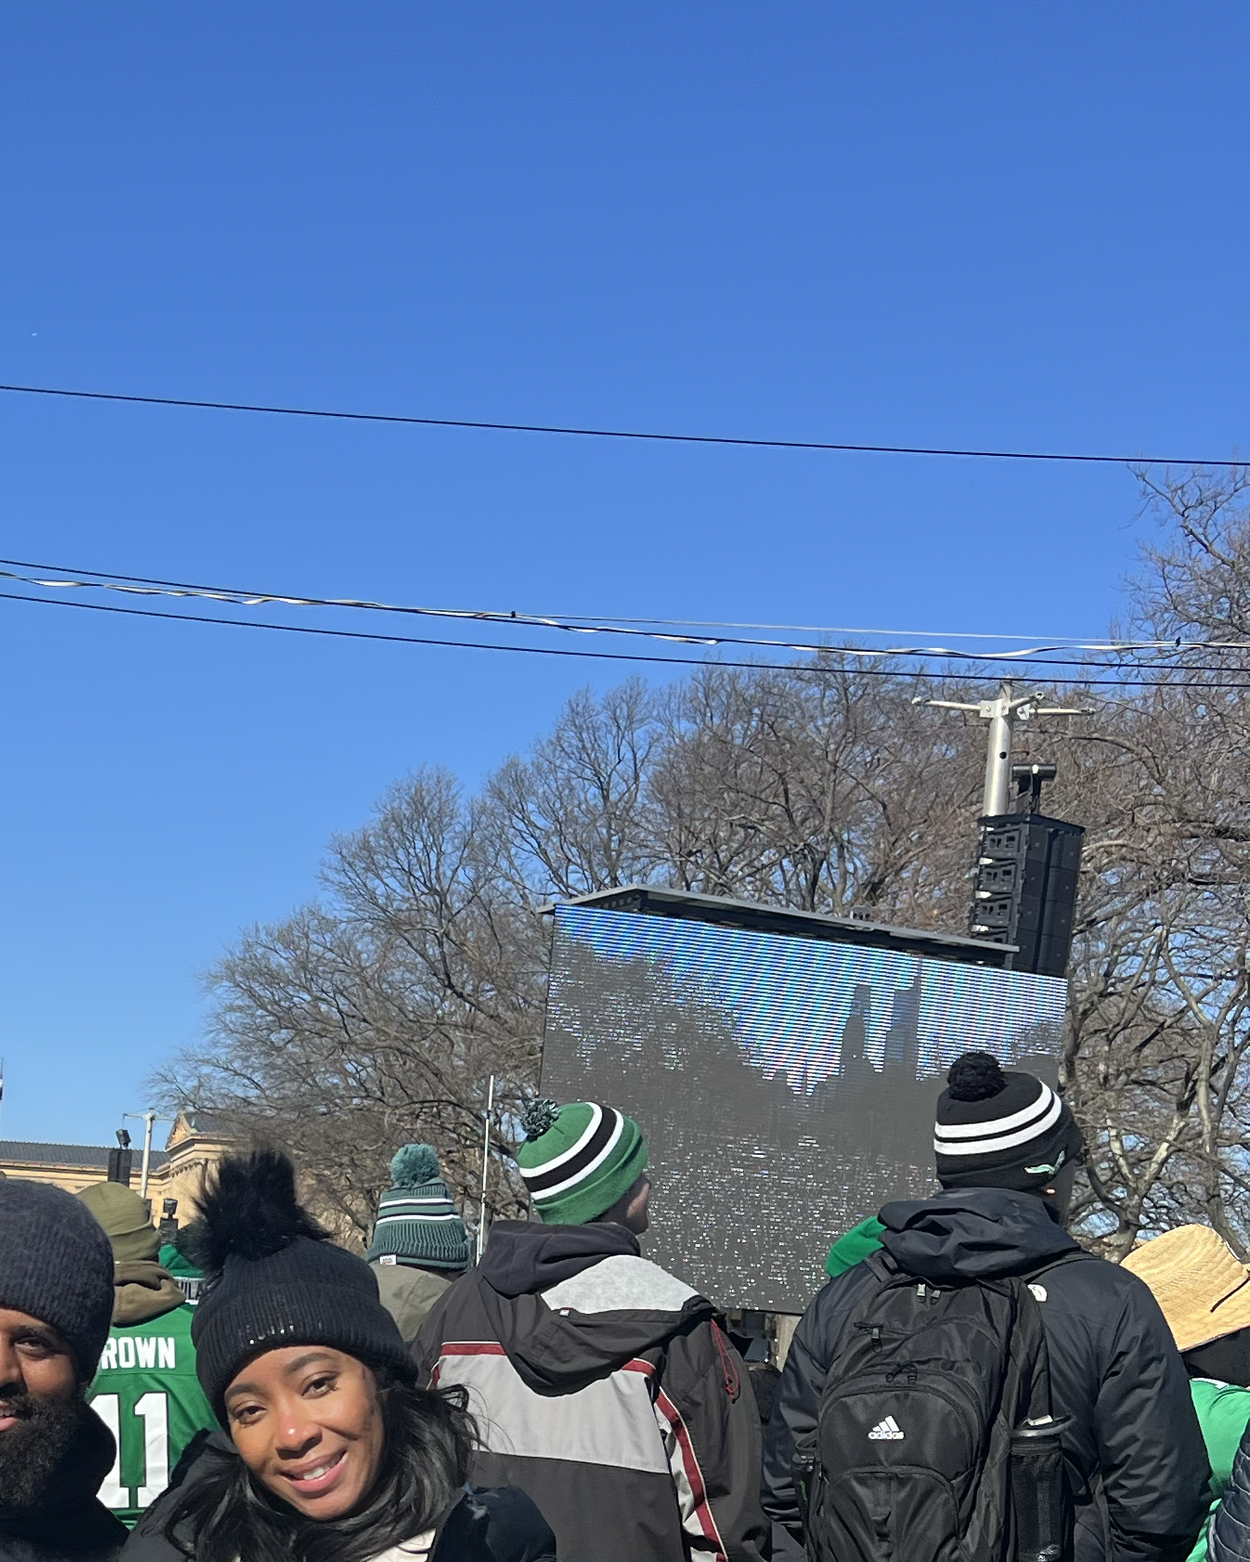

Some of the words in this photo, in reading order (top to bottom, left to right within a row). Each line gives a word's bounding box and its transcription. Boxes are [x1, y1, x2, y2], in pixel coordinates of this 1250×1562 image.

[102, 1336, 177, 1370] ROWN
[89, 1391, 171, 1510] 11
[868, 1431, 904, 1440] adidas
